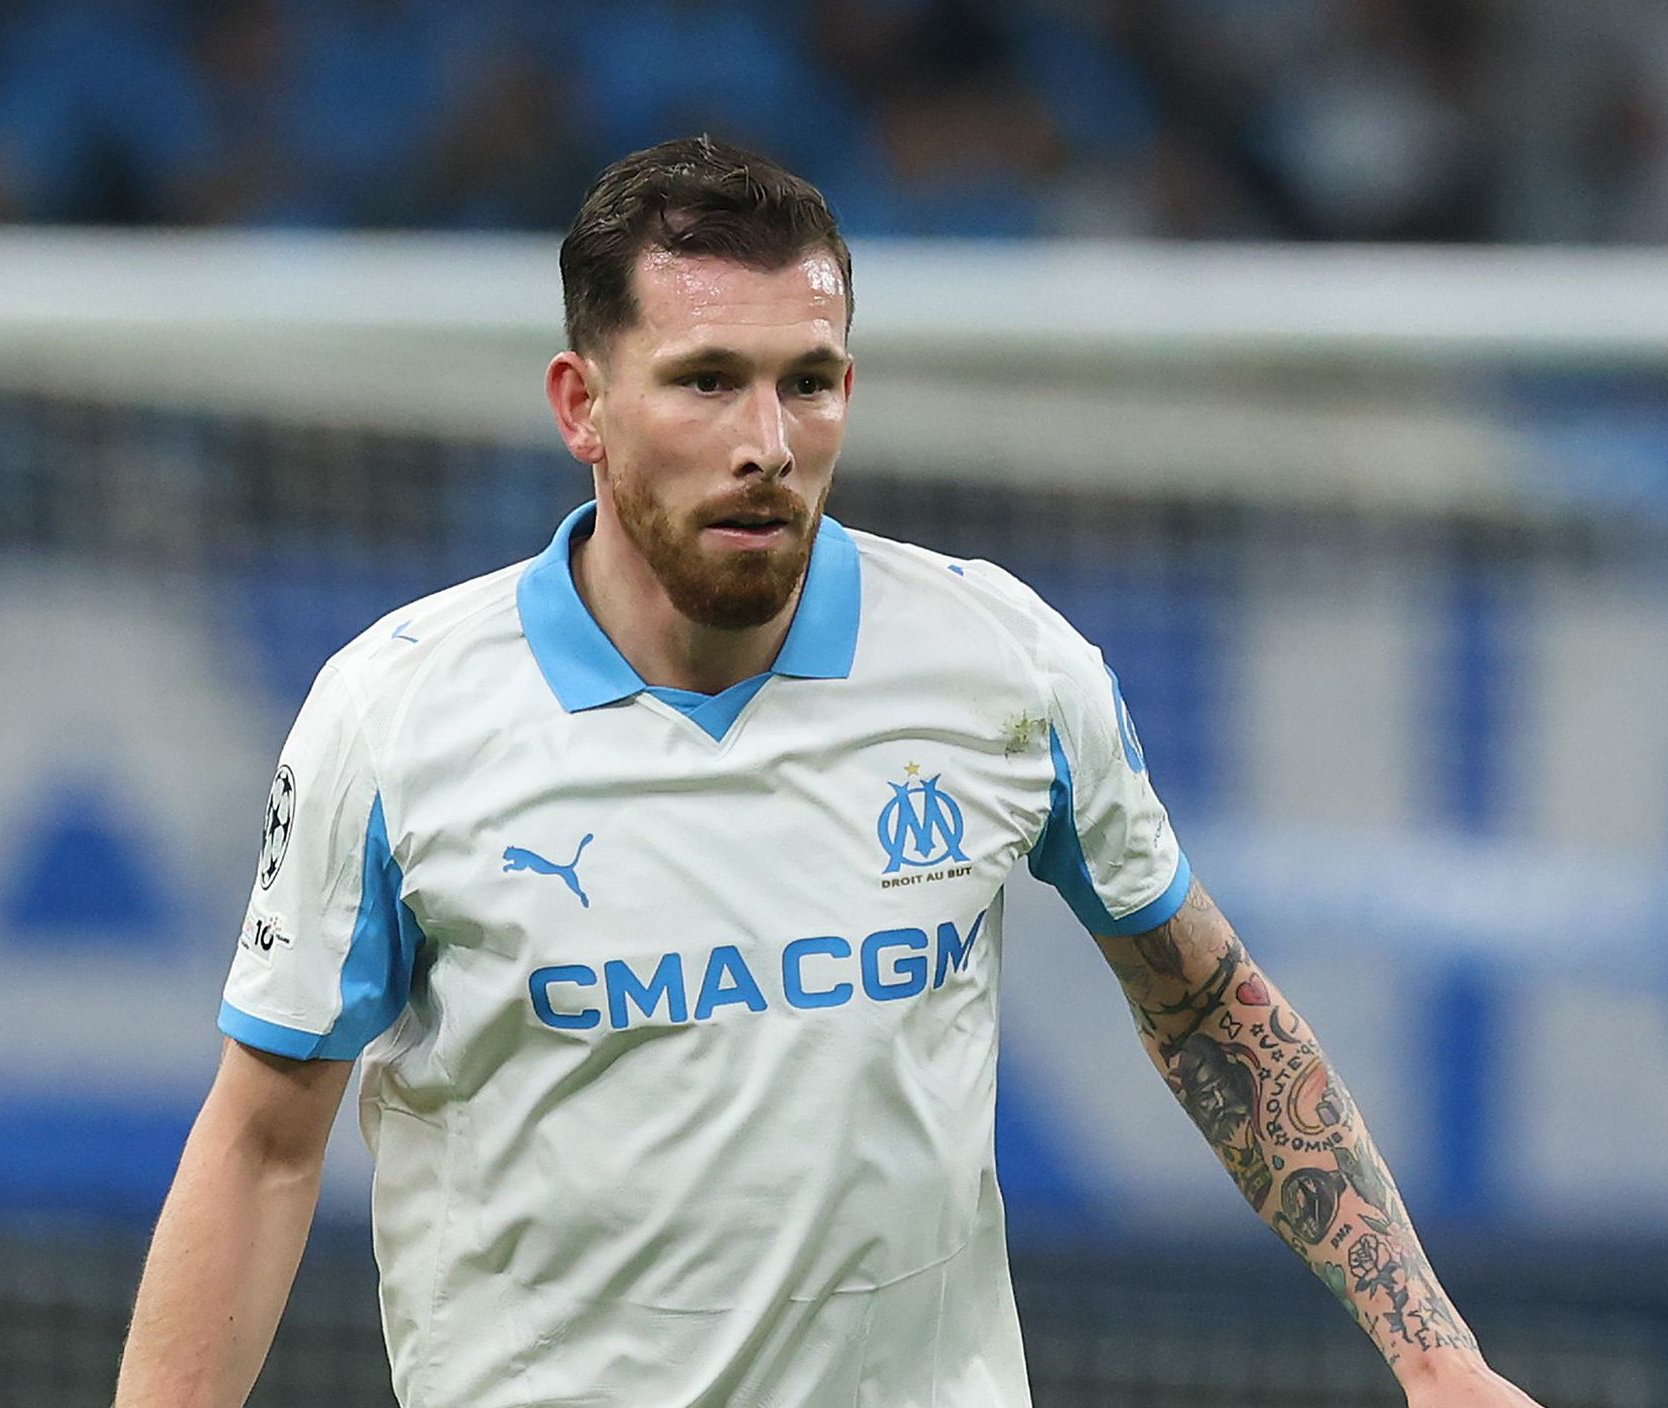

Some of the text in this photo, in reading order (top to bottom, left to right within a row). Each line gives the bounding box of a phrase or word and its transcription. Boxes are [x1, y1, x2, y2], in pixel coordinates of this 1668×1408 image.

[881, 866, 973, 889] DROIT AU BUT
[528, 908, 987, 1030] CMA CGM
